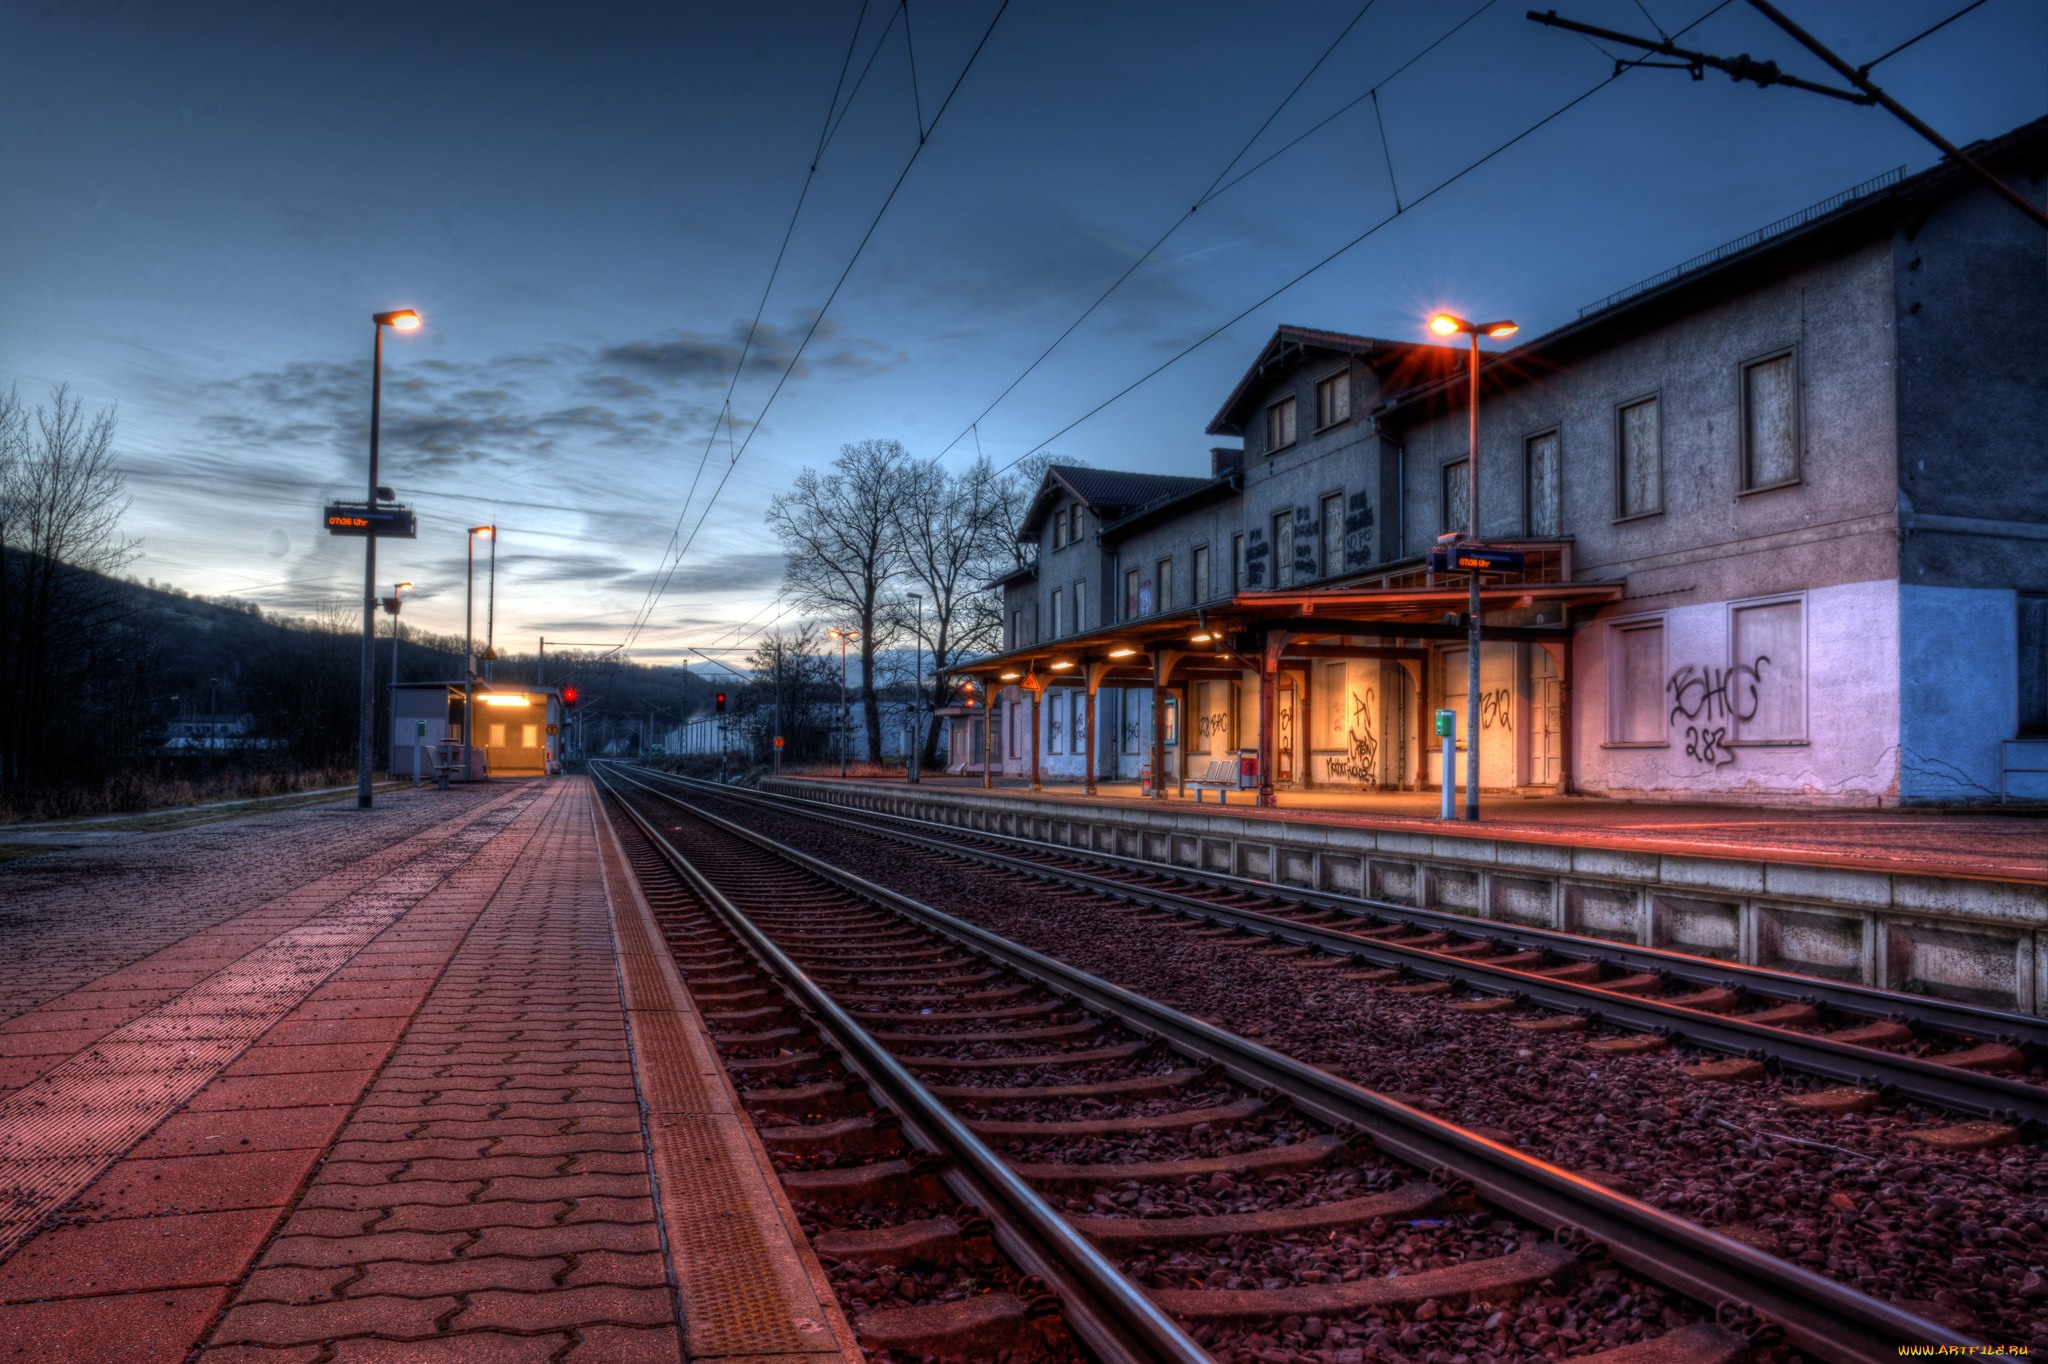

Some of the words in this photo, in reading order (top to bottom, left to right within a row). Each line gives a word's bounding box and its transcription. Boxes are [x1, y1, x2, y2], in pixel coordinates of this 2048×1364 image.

[353, 518, 368, 526] Uhr
[1478, 559, 1491, 567] Uhr
[1686, 725, 1736, 769] 283
